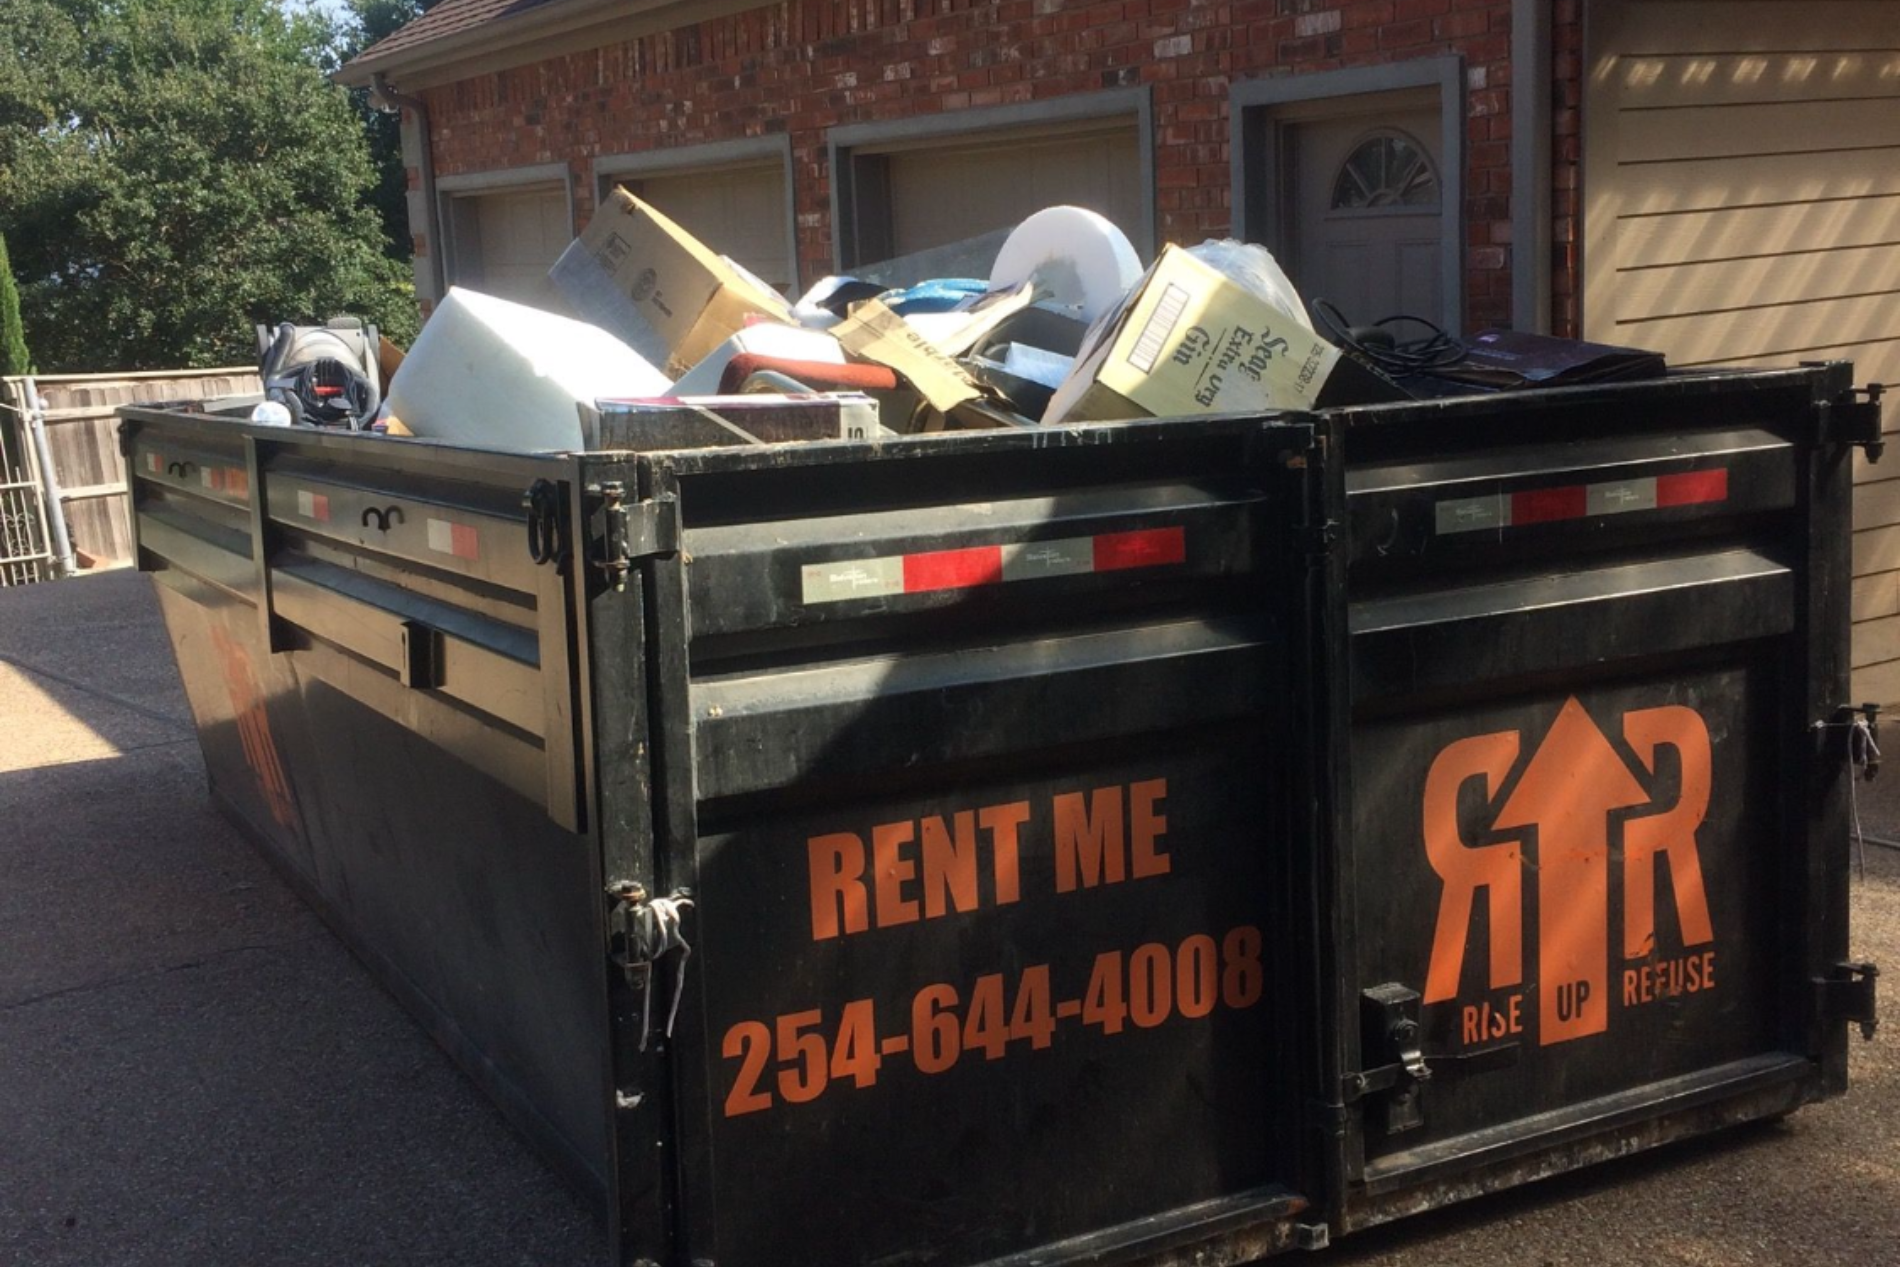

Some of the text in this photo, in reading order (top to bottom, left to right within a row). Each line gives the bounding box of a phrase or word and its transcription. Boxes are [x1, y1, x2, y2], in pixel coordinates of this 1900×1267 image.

[1173, 325, 1210, 367] Gin
[807, 777, 1171, 941] RENT ME
[721, 925, 1263, 1118] 254-644-4008
[1463, 952, 1716, 1045] RISE UP REFUSE
